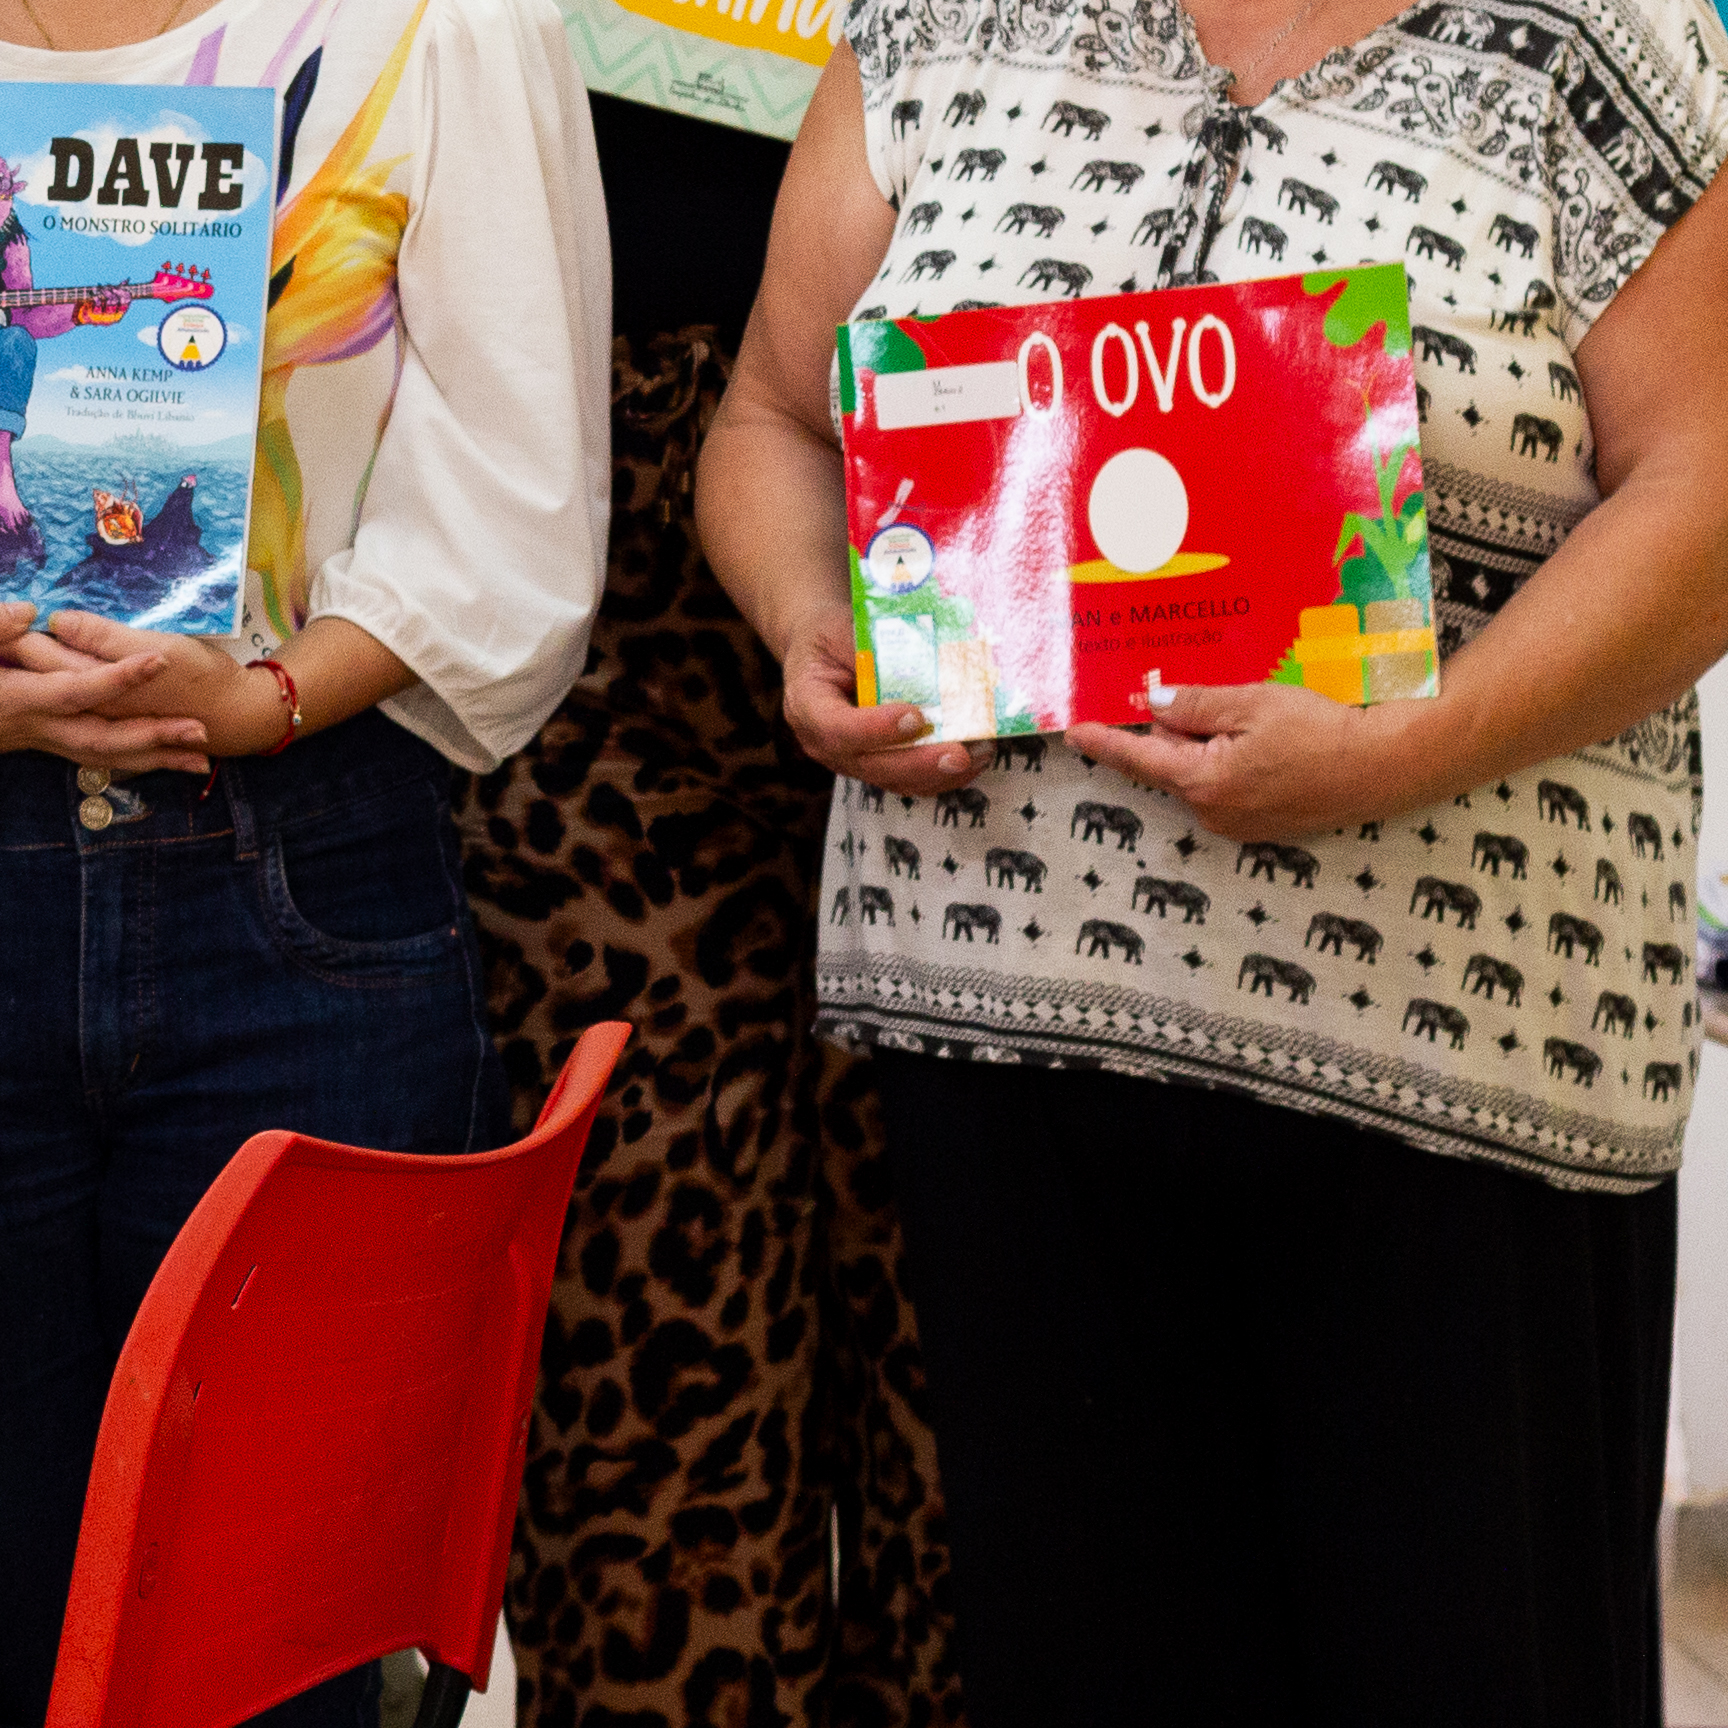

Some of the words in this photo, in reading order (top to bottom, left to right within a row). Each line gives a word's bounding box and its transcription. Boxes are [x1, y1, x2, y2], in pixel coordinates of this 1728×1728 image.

[46, 136, 245, 212] DAVE
[43, 215, 56, 231] O
[60, 216, 146, 235] MONSTRO
[149, 217, 243, 239] SOLITÁRIO
[86, 365, 128, 383] ANNA
[132, 367, 173, 384] KEMP
[1017, 331, 1064, 422] O
[1091, 313, 1237, 418] OVO
[70, 385, 80, 399] &
[83, 386, 123, 402] SARA
[126, 388, 186, 404] OGILVIE
[1109, 610, 1122, 626] e
[1129, 596, 1251, 624] MARCELLO
